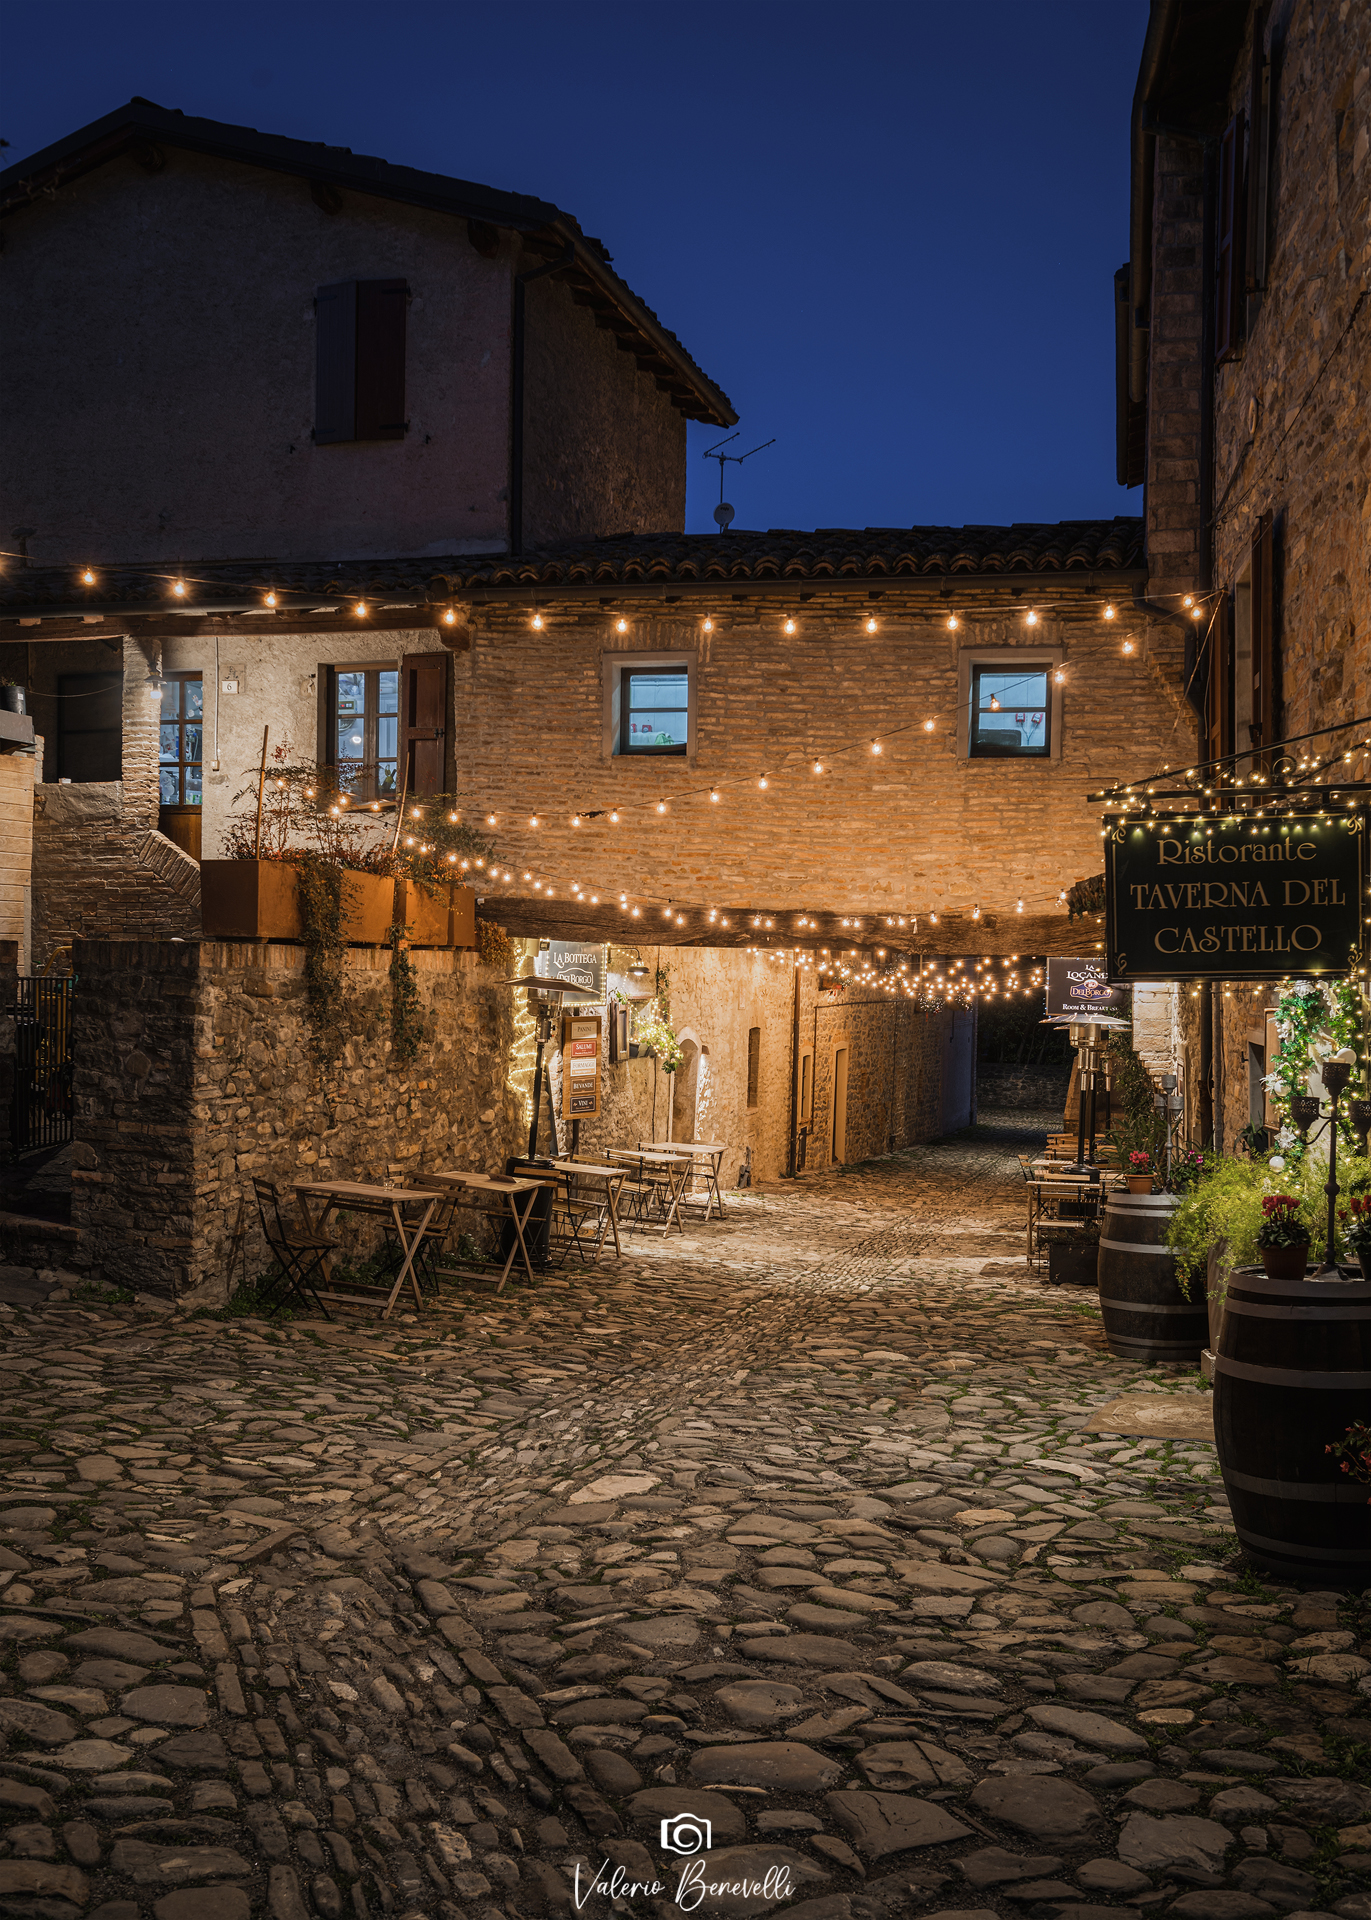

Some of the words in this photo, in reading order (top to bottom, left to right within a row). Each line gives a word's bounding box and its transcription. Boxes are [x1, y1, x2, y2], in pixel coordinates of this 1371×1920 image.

[226, 683, 232, 691] 6
[1156, 836, 1317, 865] Ristorante
[1130, 880, 1270, 910] TAVERNA
[1282, 878, 1346, 907] DEL
[1154, 924, 1322, 954] CASTELLO
[564, 952, 597, 964] BOTTEGA
